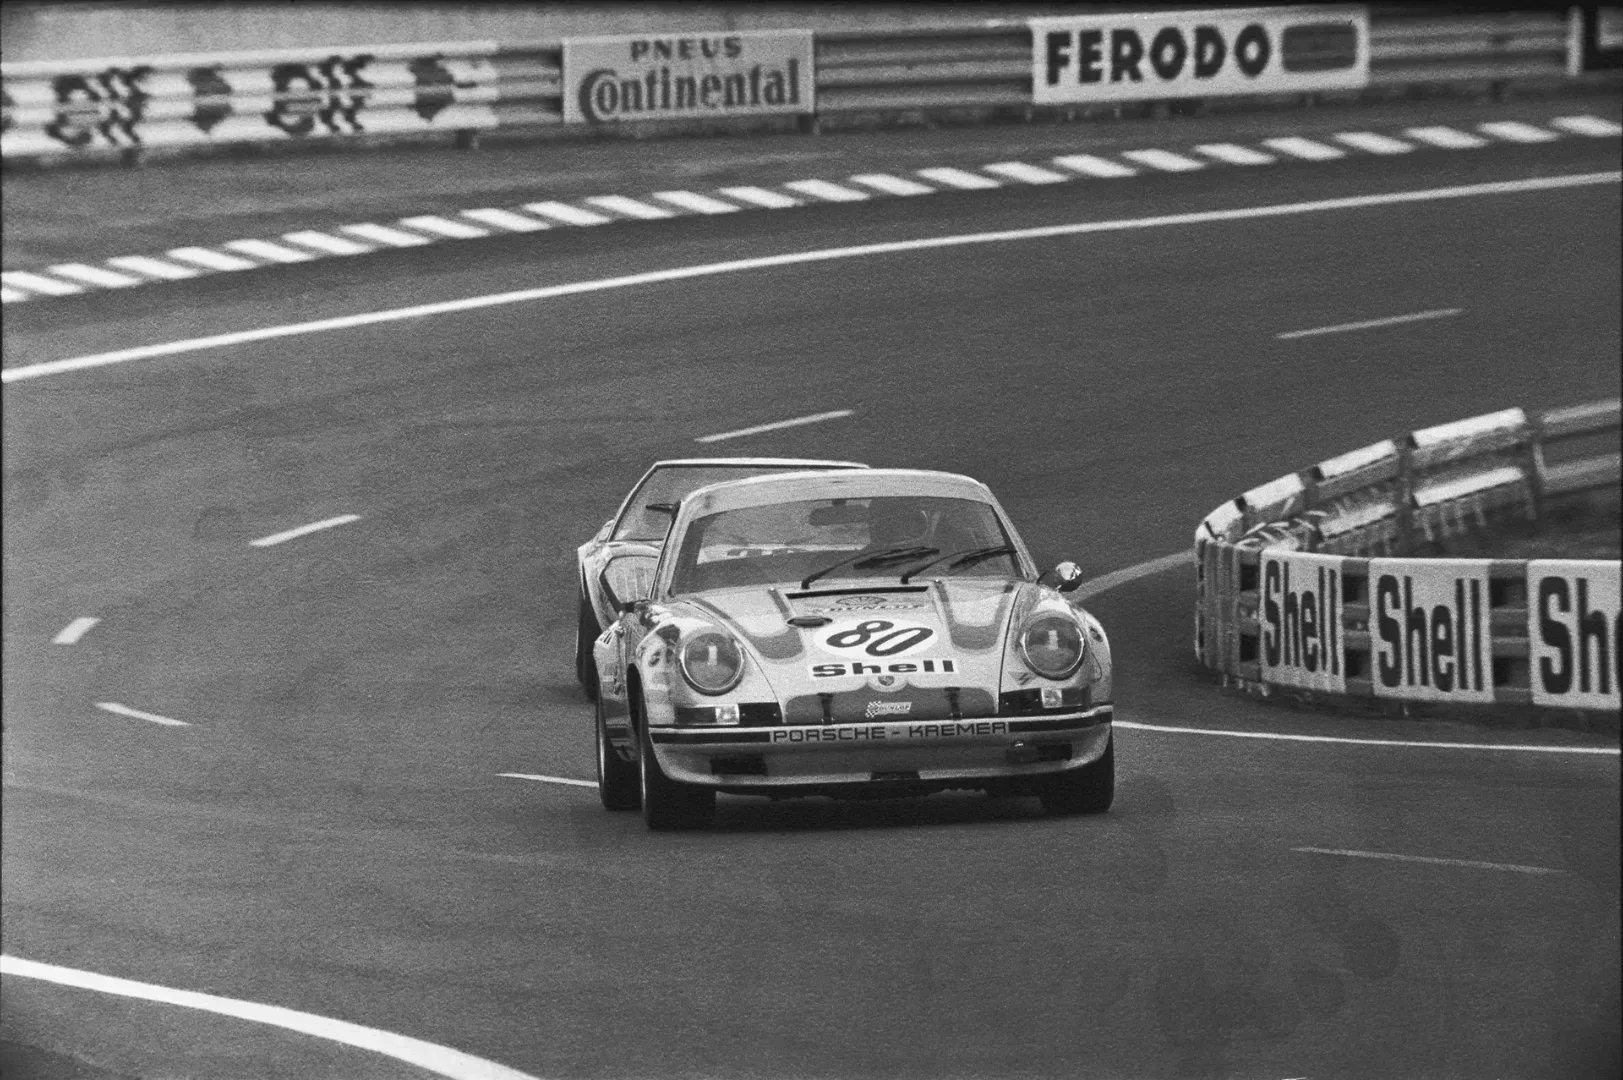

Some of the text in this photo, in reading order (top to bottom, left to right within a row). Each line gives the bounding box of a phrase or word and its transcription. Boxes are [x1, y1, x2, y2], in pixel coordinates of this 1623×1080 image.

[631, 36, 743, 61] PNEUS
[1046, 23, 1271, 86] FERODO
[578, 58, 799, 124] Continental
[825, 619, 935, 657] 80
[1263, 559, 1340, 677] Shell
[1376, 573, 1485, 693] Shell
[1539, 576, 1622, 694] Sh
[812, 659, 955, 678] Shell
[773, 726, 886, 743] PORSCHE
[908, 721, 1010, 738] KREMER
